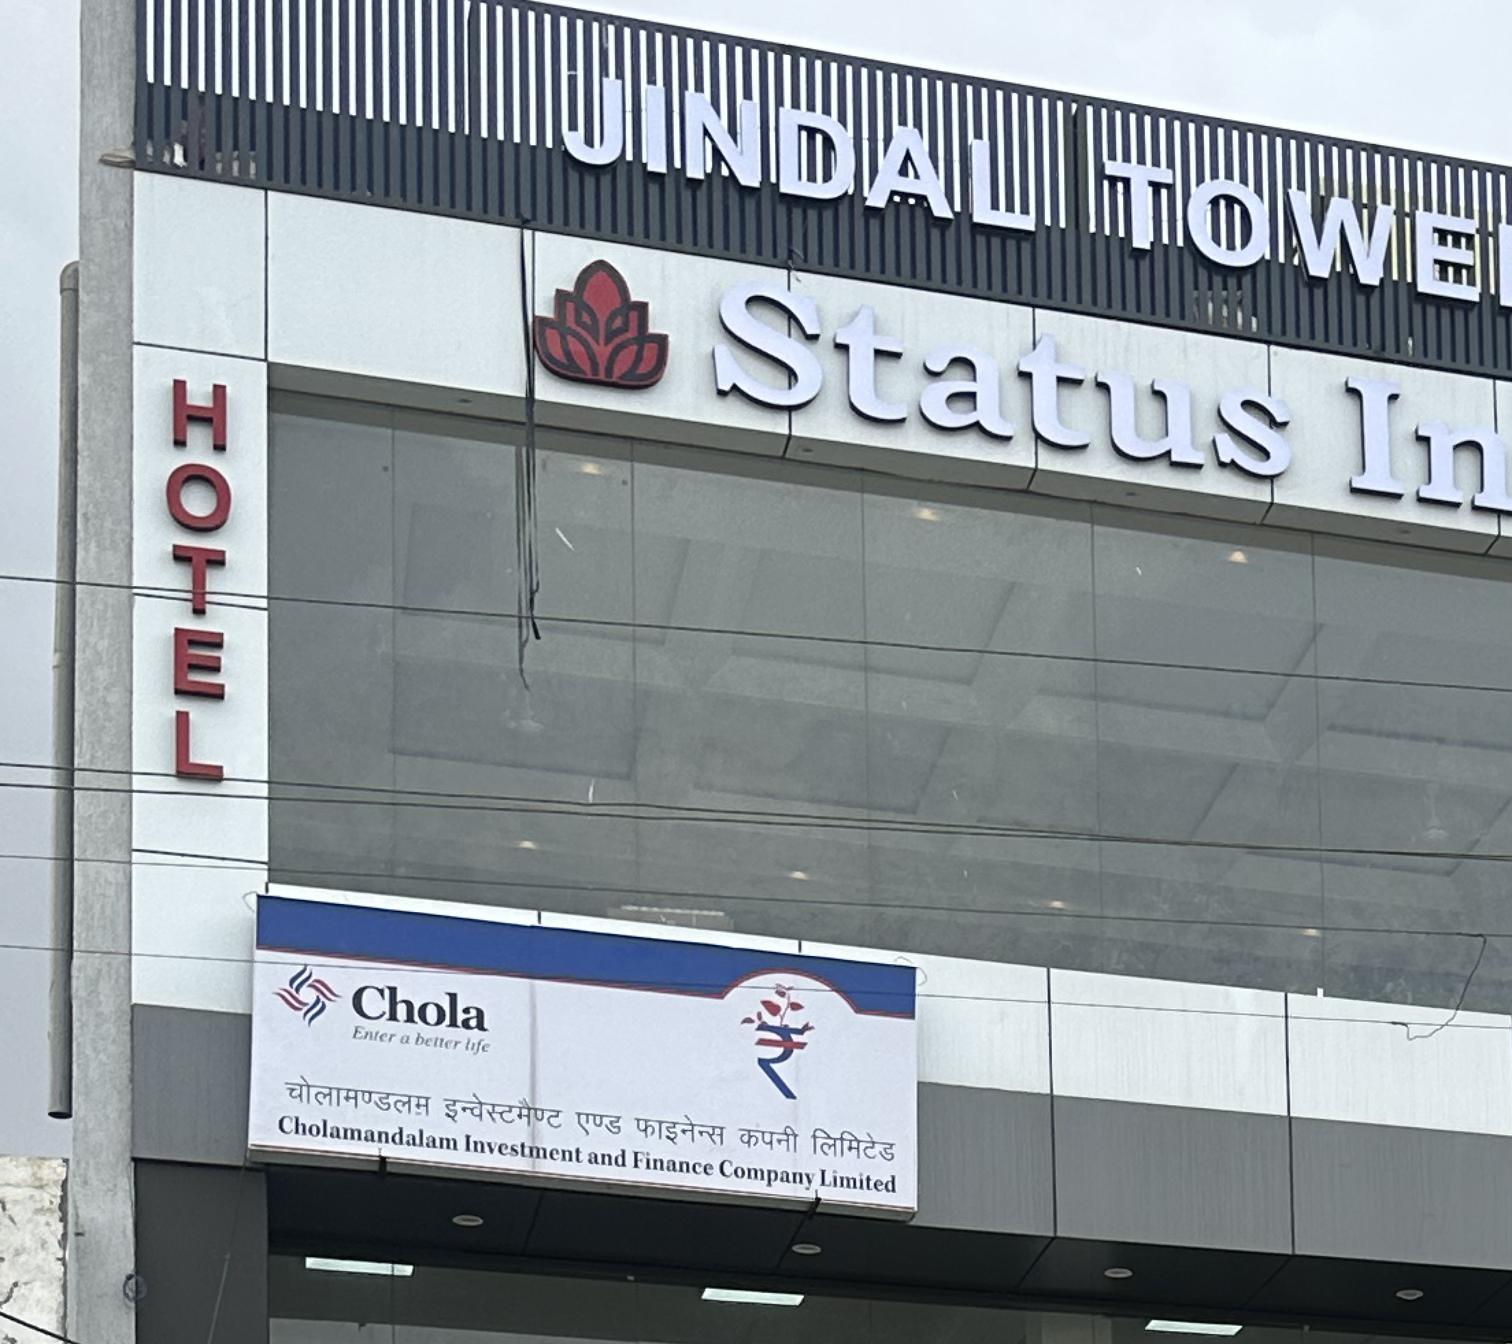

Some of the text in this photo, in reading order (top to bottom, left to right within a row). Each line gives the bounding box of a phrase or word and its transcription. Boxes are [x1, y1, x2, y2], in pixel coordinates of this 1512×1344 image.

[562, 76, 1036, 235] JINDAL
[712, 279, 1292, 478] Status
[166, 379, 232, 782] HOTEL
[352, 984, 488, 1032] Chola
[352, 1026, 491, 1055] Enter a better life
[278, 1115, 896, 1193] Cholamandalam Investment and Finance Company Limited
[576, 1112, 622, 1136] एण्ड
[634, 1115, 726, 1146] फाइनेन्स
[811, 1128, 895, 1161] लिमिटेड
